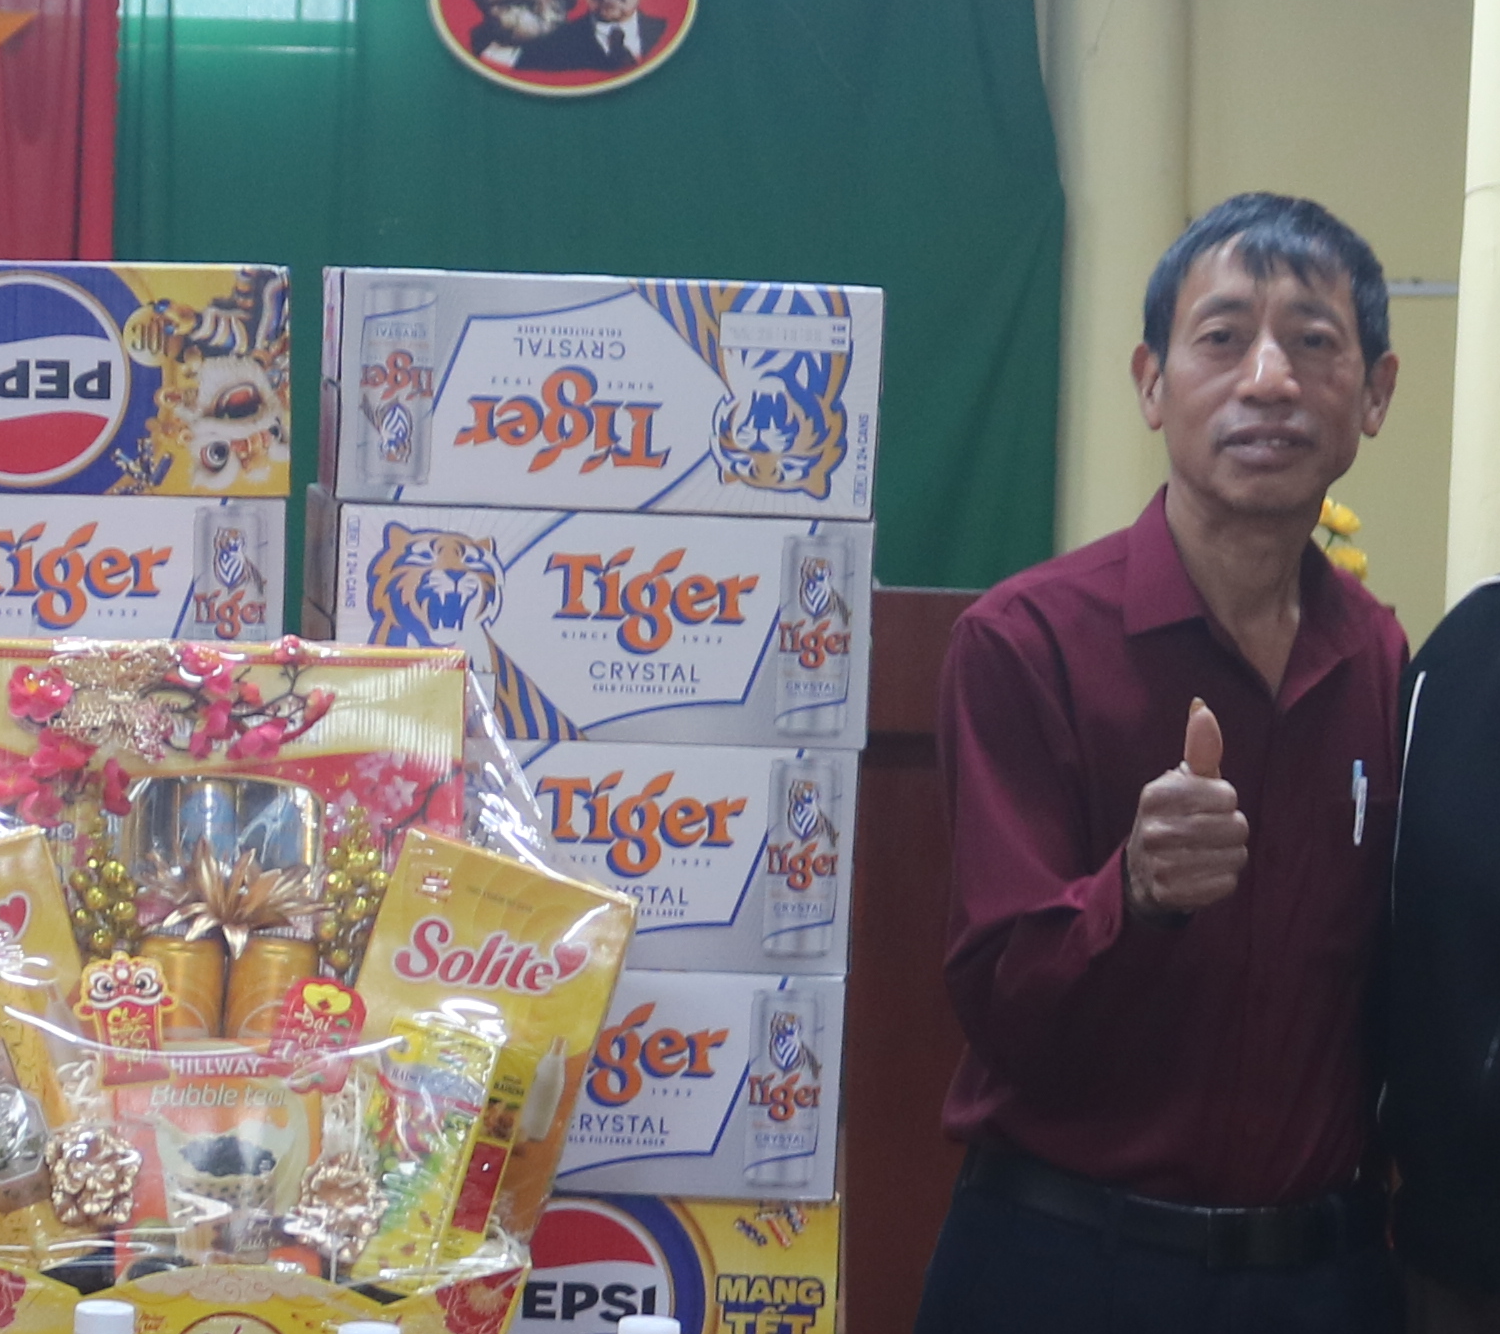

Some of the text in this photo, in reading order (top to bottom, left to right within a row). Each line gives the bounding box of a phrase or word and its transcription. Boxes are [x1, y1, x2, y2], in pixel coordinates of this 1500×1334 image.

[513, 337, 626, 360] CRYSTAL
[589, 660, 701, 683] CRYSTAL
[393, 917, 555, 993] Solite
[168, 1056, 260, 1076] HILLWAY
[586, 1001, 730, 1107] ger
[151, 1083, 239, 1107] Bubble
[572, 1113, 670, 1134] RYSTAL
[521, 1280, 656, 1322] EPSI
[716, 1274, 824, 1307] MANG
